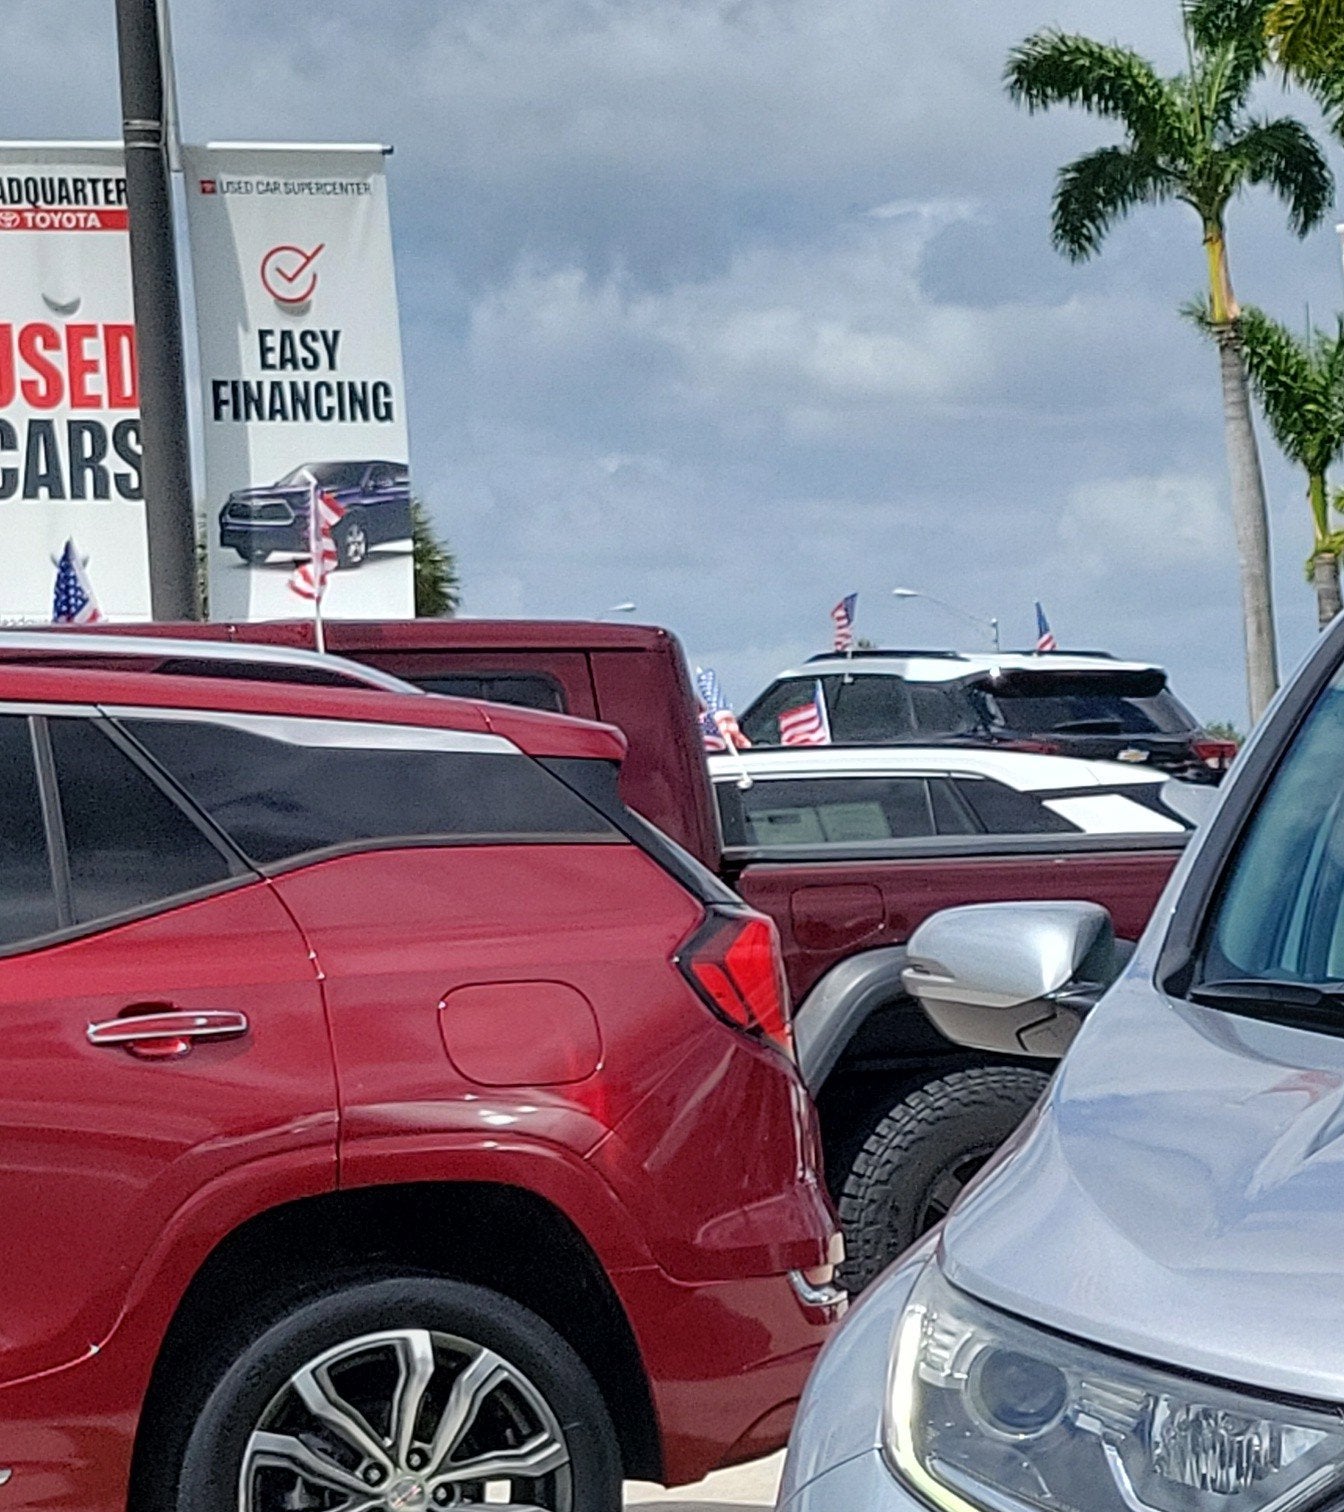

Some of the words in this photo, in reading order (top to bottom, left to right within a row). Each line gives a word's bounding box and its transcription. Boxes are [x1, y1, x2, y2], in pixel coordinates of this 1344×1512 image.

[220, 180, 253, 195] USED
[256, 180, 281, 195] CAR
[284, 180, 371, 196] SUPERCENTER
[23, 211, 101, 229] TOYOTA
[258, 329, 341, 371] EASY
[212, 379, 394, 422] FINANCING
